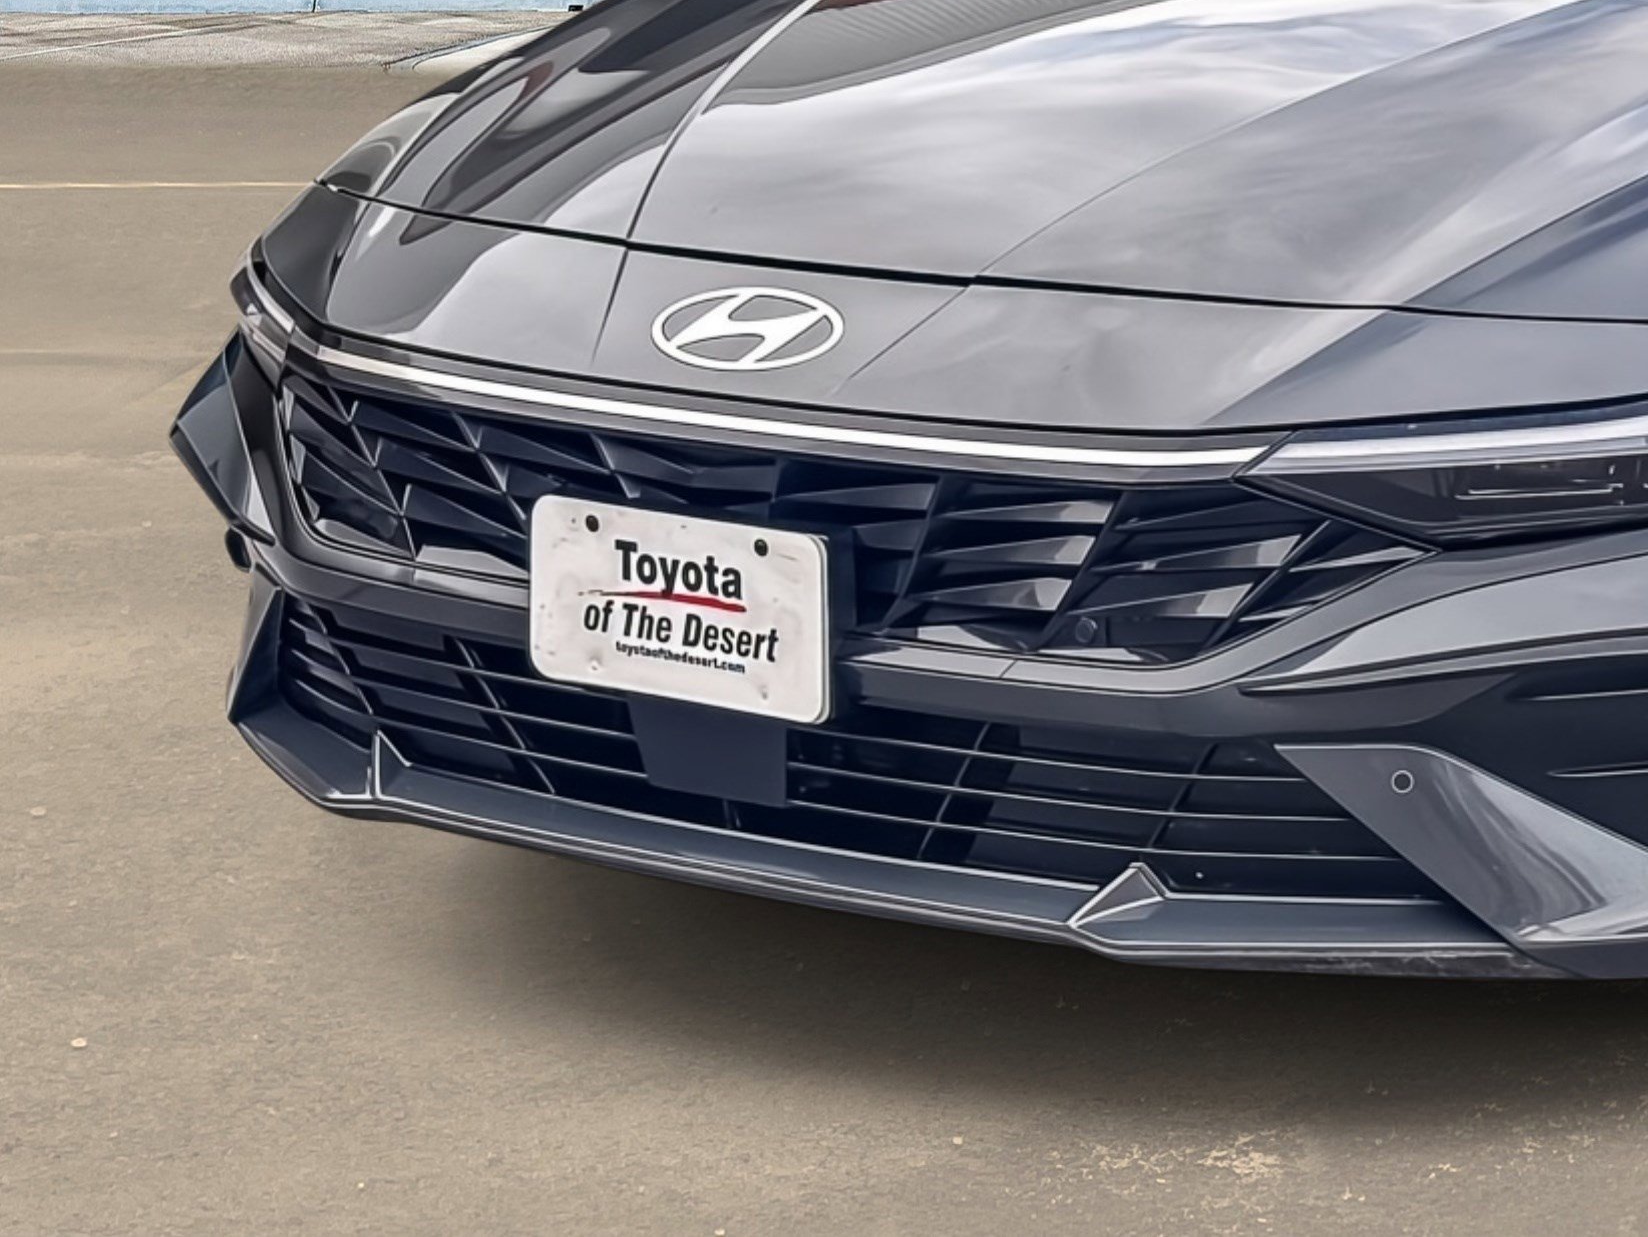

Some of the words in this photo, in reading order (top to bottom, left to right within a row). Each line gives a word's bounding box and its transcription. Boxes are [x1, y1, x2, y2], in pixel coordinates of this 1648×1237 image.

[614, 538, 743, 601] Toyota
[583, 600, 615, 633] of
[622, 602, 672, 643] The
[682, 613, 779, 663] Desert
[616, 641, 746, 674] toyotaofthedesert.com
